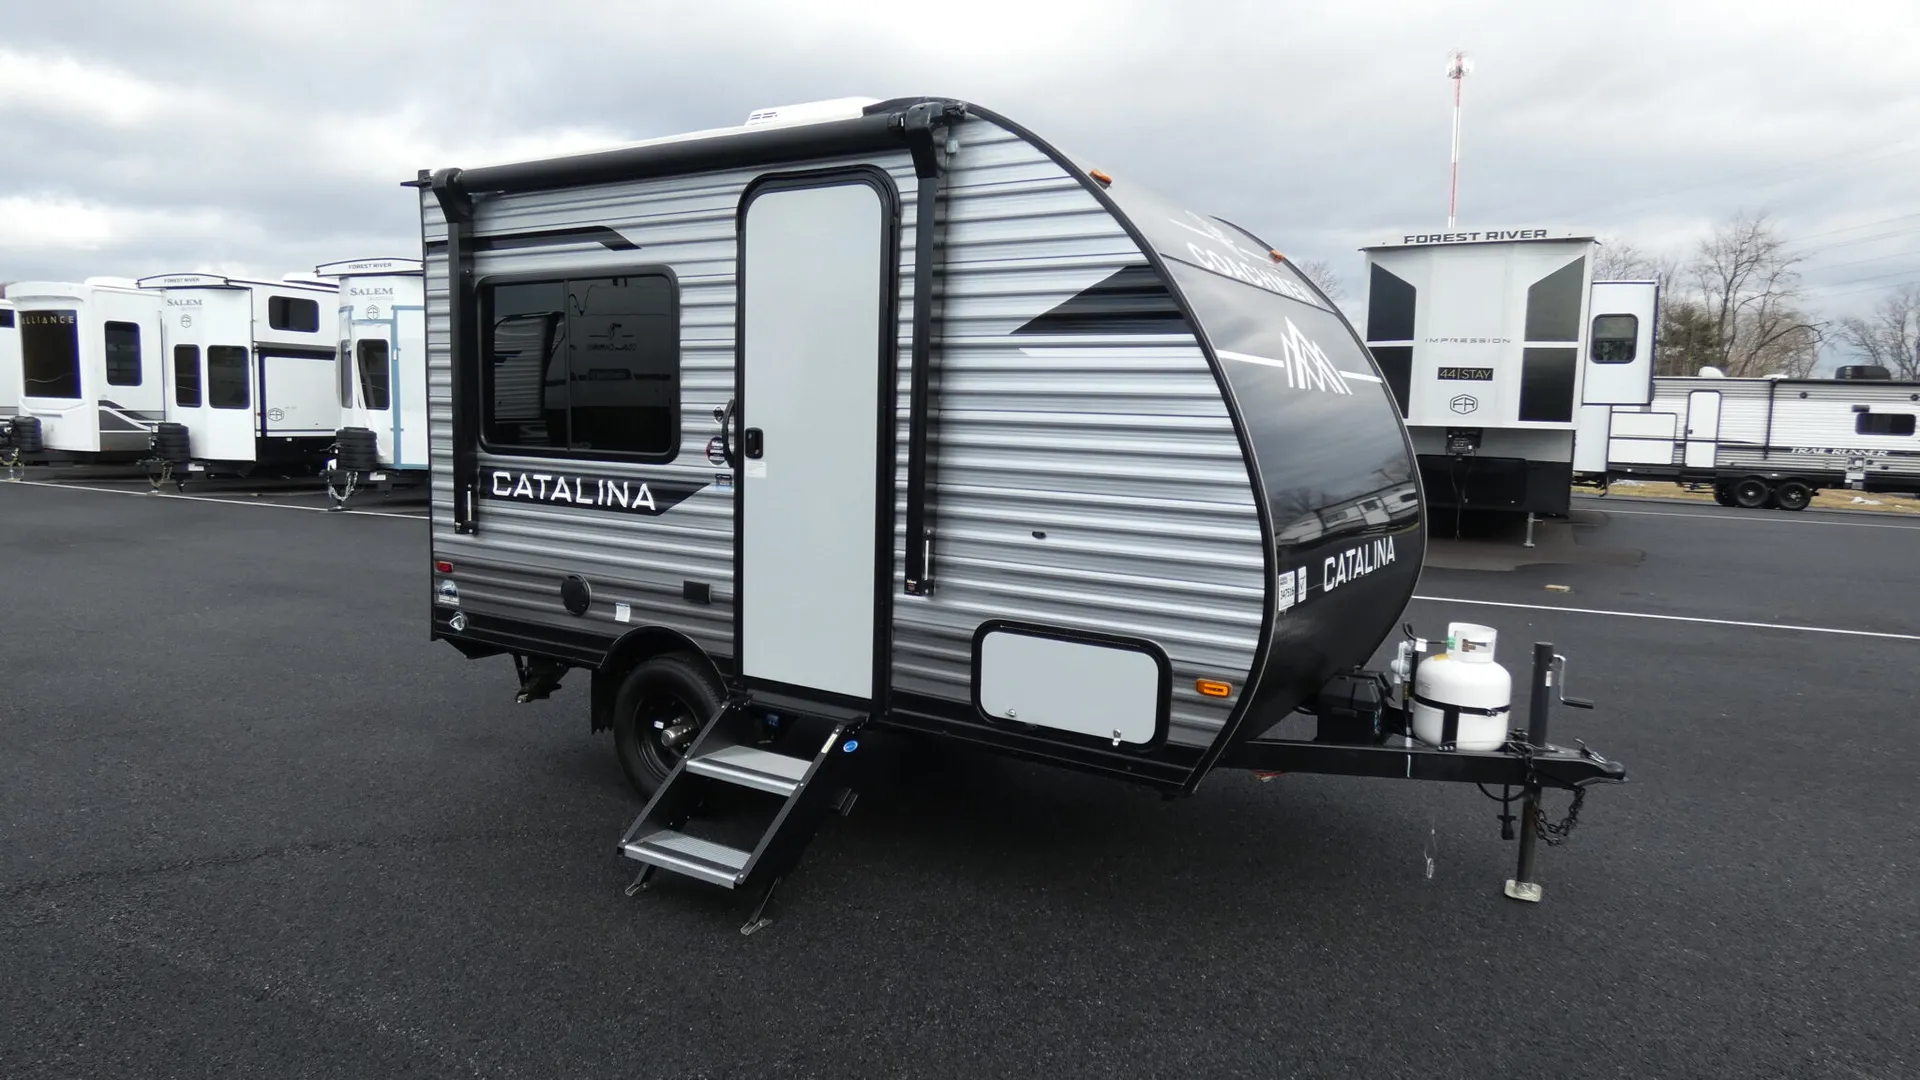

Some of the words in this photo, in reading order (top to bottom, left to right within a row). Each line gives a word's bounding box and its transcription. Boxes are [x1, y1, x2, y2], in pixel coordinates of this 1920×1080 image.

[1404, 232, 1481, 244] FOREST
[1486, 229, 1548, 240] RIVER
[350, 287, 394, 296] SALEM
[492, 471, 656, 511] CATALINA
[1324, 535, 1396, 592] CATALINA
